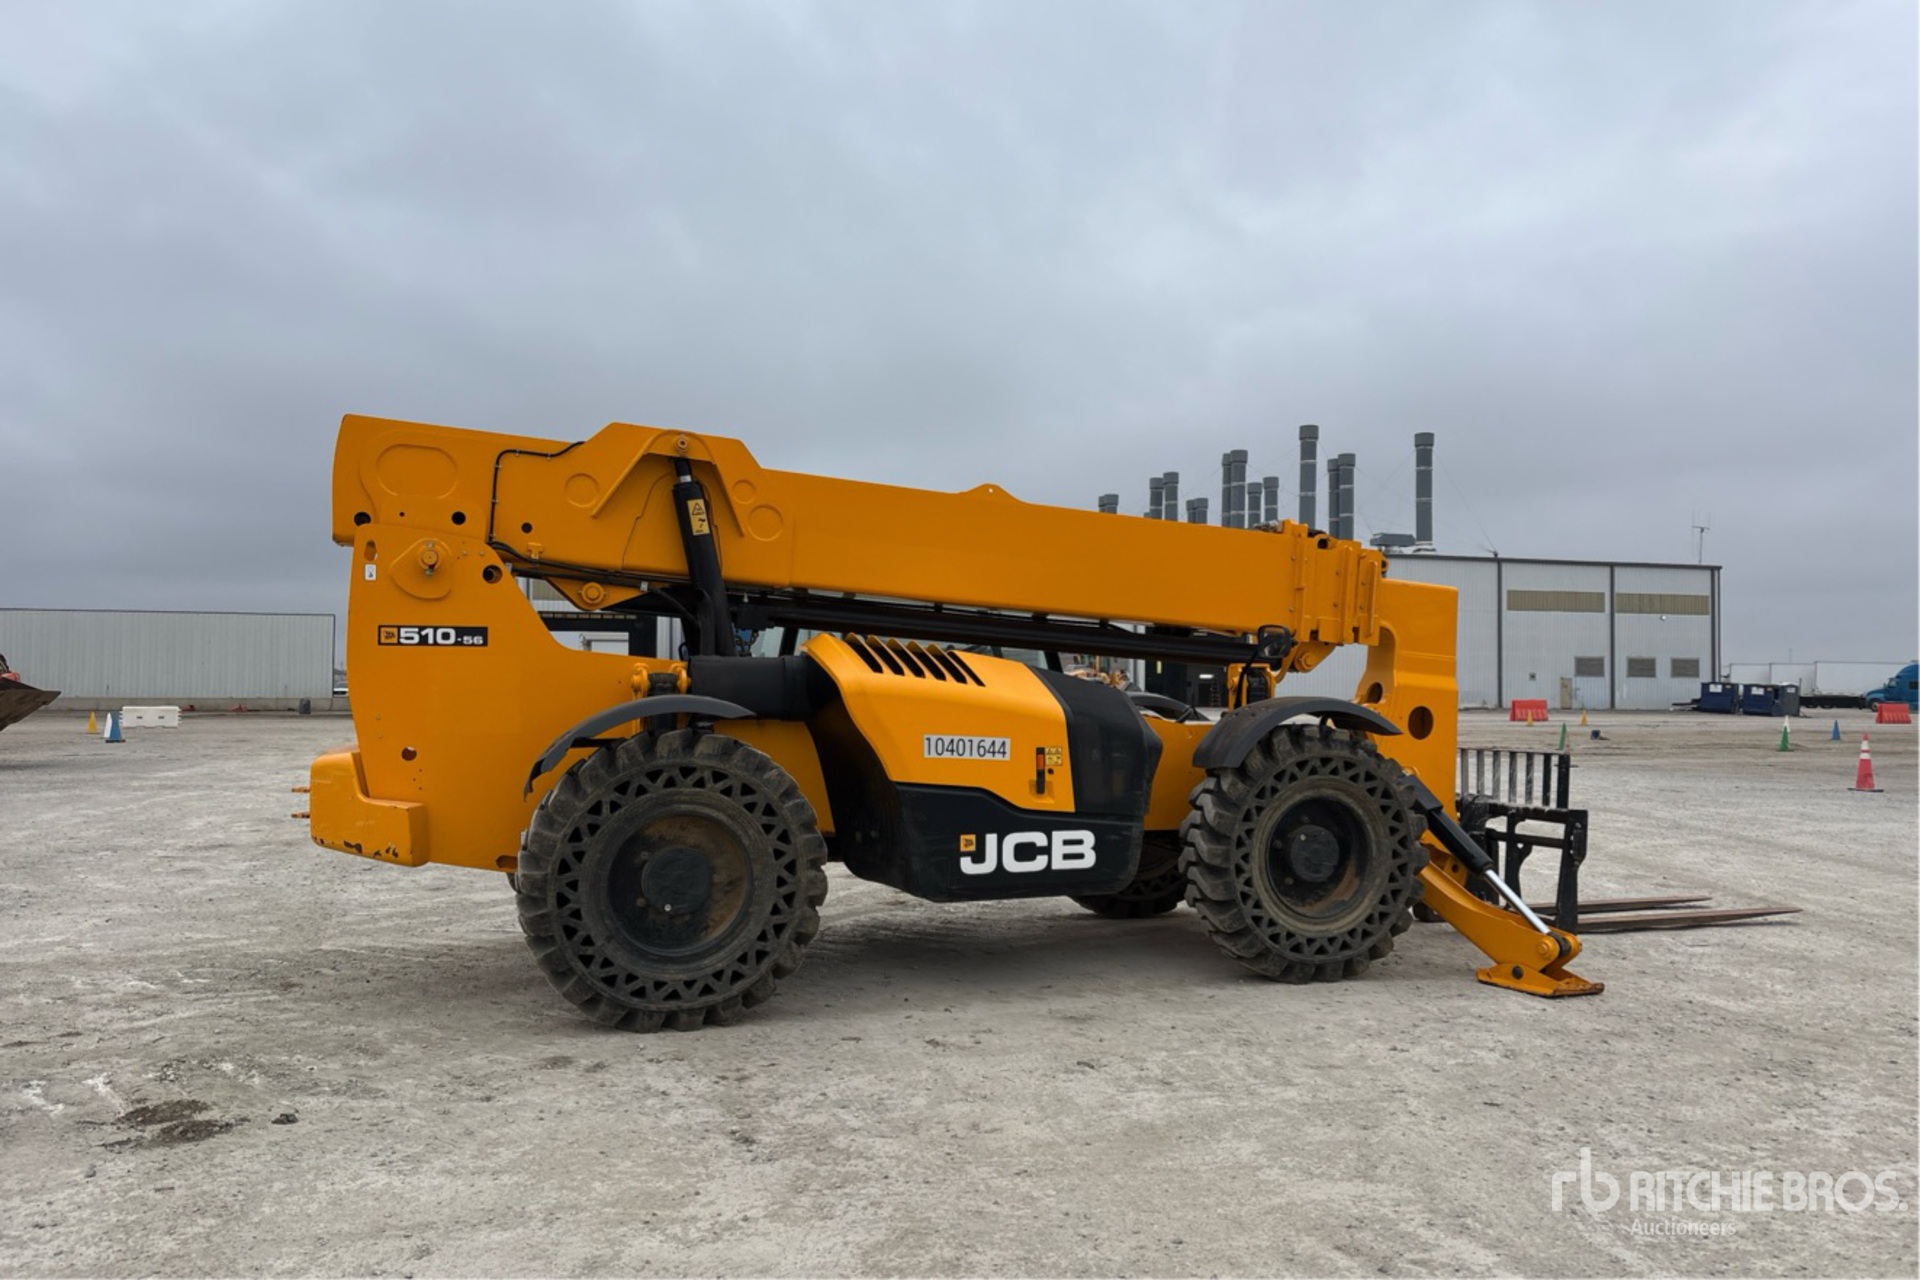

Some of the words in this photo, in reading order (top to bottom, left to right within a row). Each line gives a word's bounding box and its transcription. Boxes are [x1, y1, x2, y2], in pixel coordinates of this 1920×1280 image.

[399, 627, 484, 645] 510-56
[925, 737, 1007, 758] 10401644
[959, 829, 1096, 875] JCB
